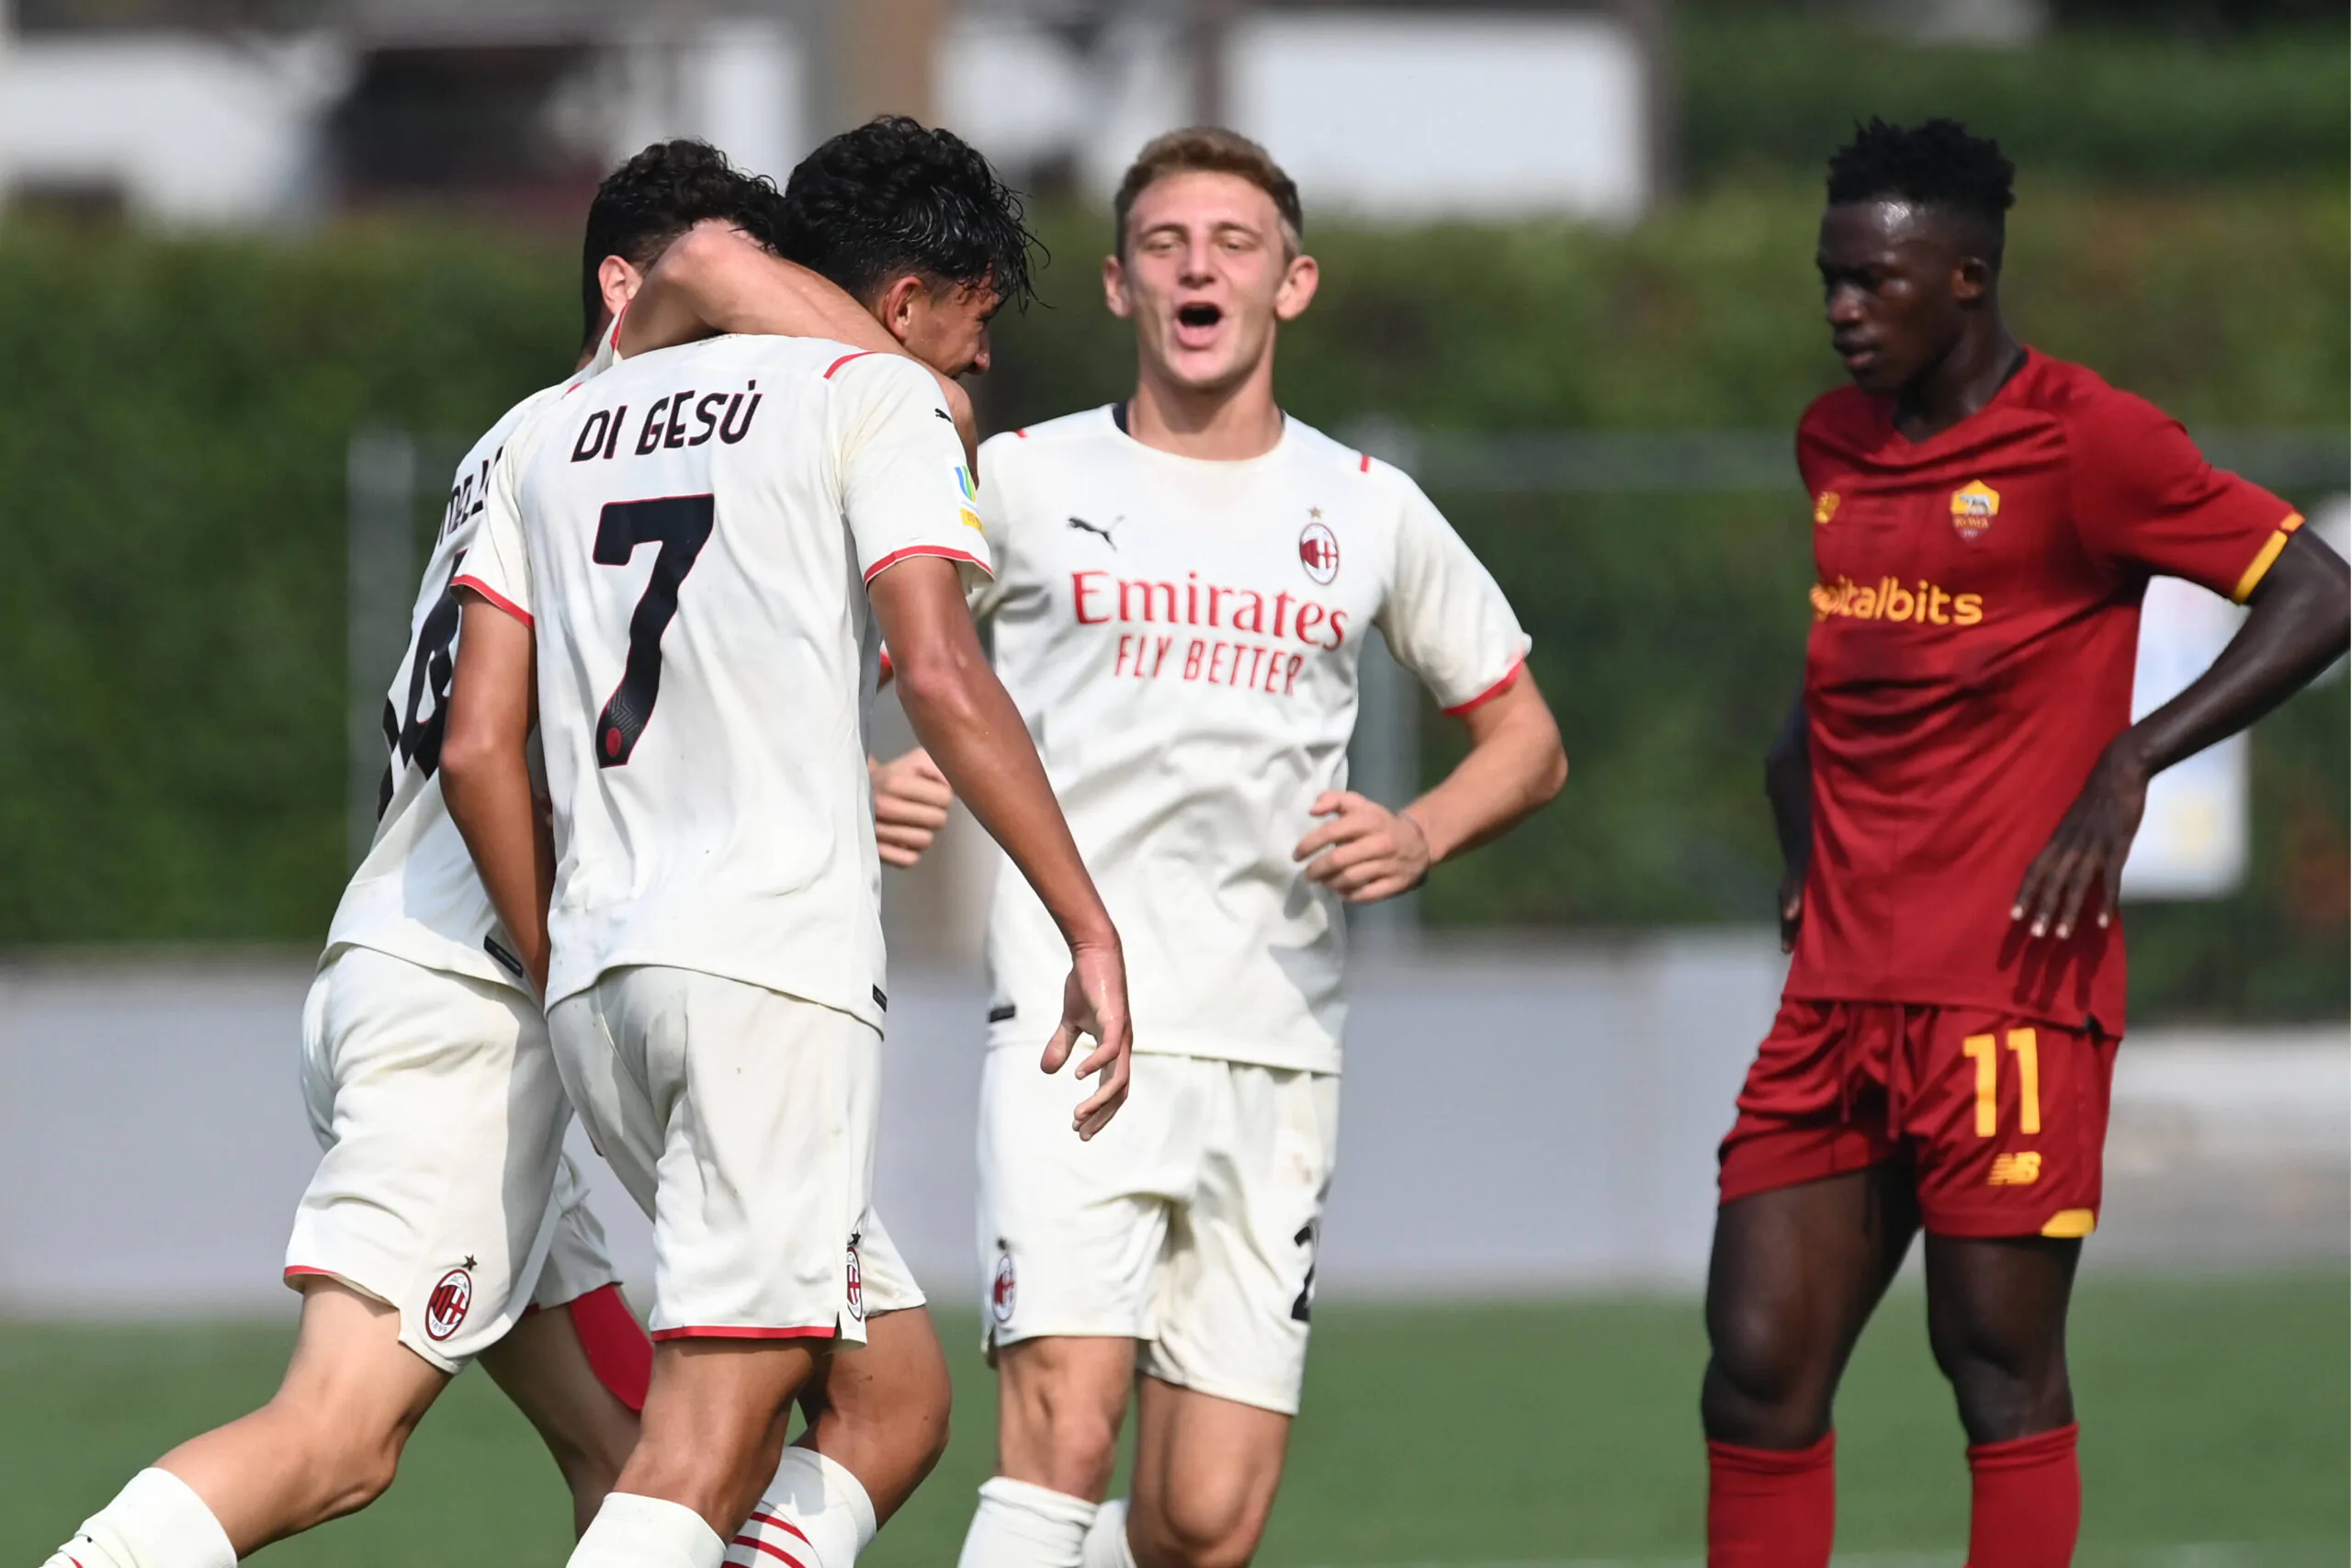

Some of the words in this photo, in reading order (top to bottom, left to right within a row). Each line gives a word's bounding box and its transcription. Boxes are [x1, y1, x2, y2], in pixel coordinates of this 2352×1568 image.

[571, 405, 628, 463] DI
[593, 492, 715, 769] 7
[1071, 570, 1349, 652] Emirates
[1114, 633, 1174, 678] FLY
[1183, 638, 1305, 696] BETTER
[1962, 1027, 2041, 1138] 11
